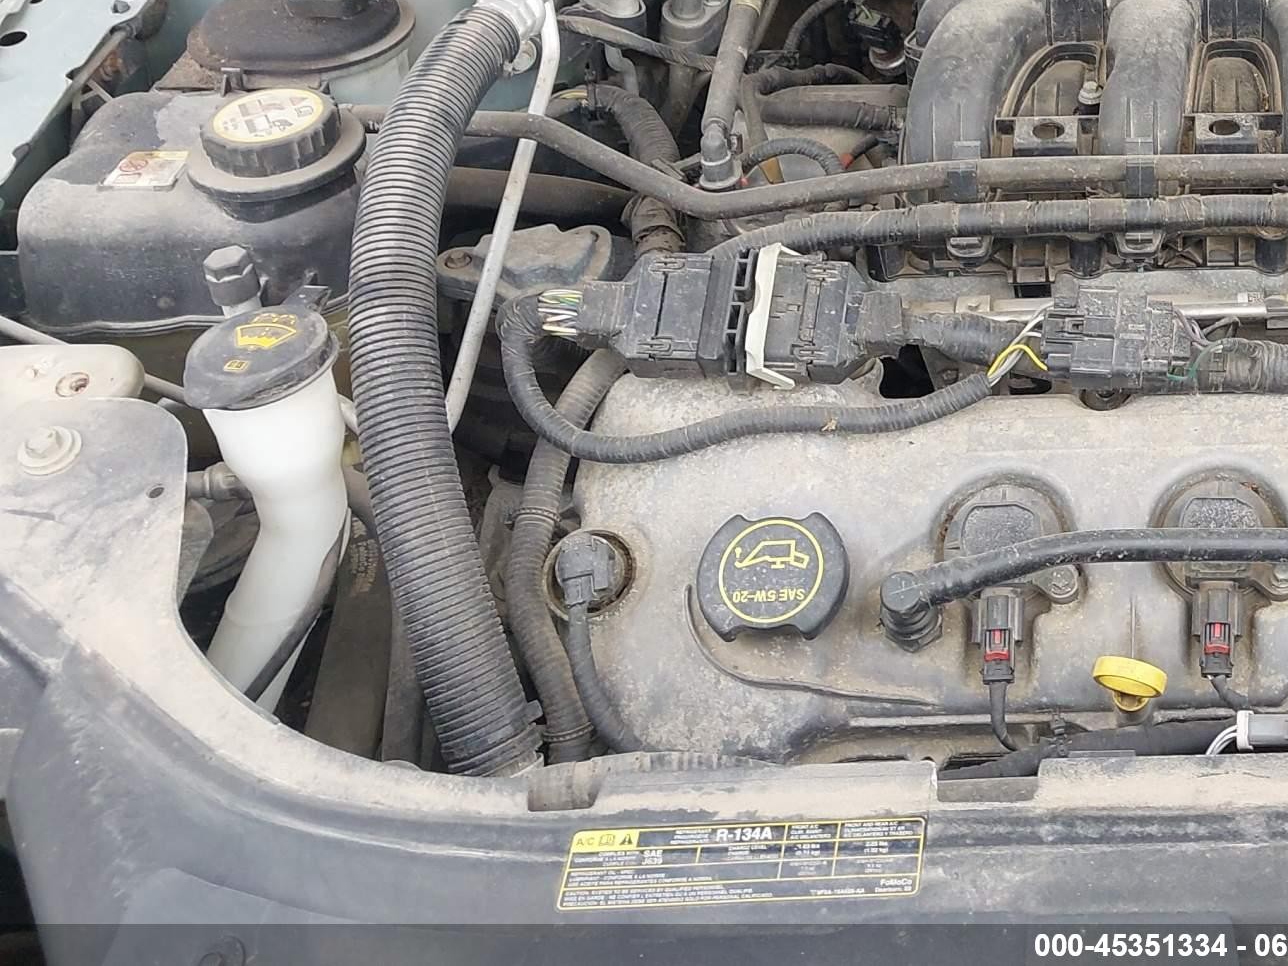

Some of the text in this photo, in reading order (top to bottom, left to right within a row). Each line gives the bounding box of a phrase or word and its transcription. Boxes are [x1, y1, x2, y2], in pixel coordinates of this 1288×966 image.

[732, 588, 805, 602] SAE 5W-20
[716, 826, 772, 842] R-134A
